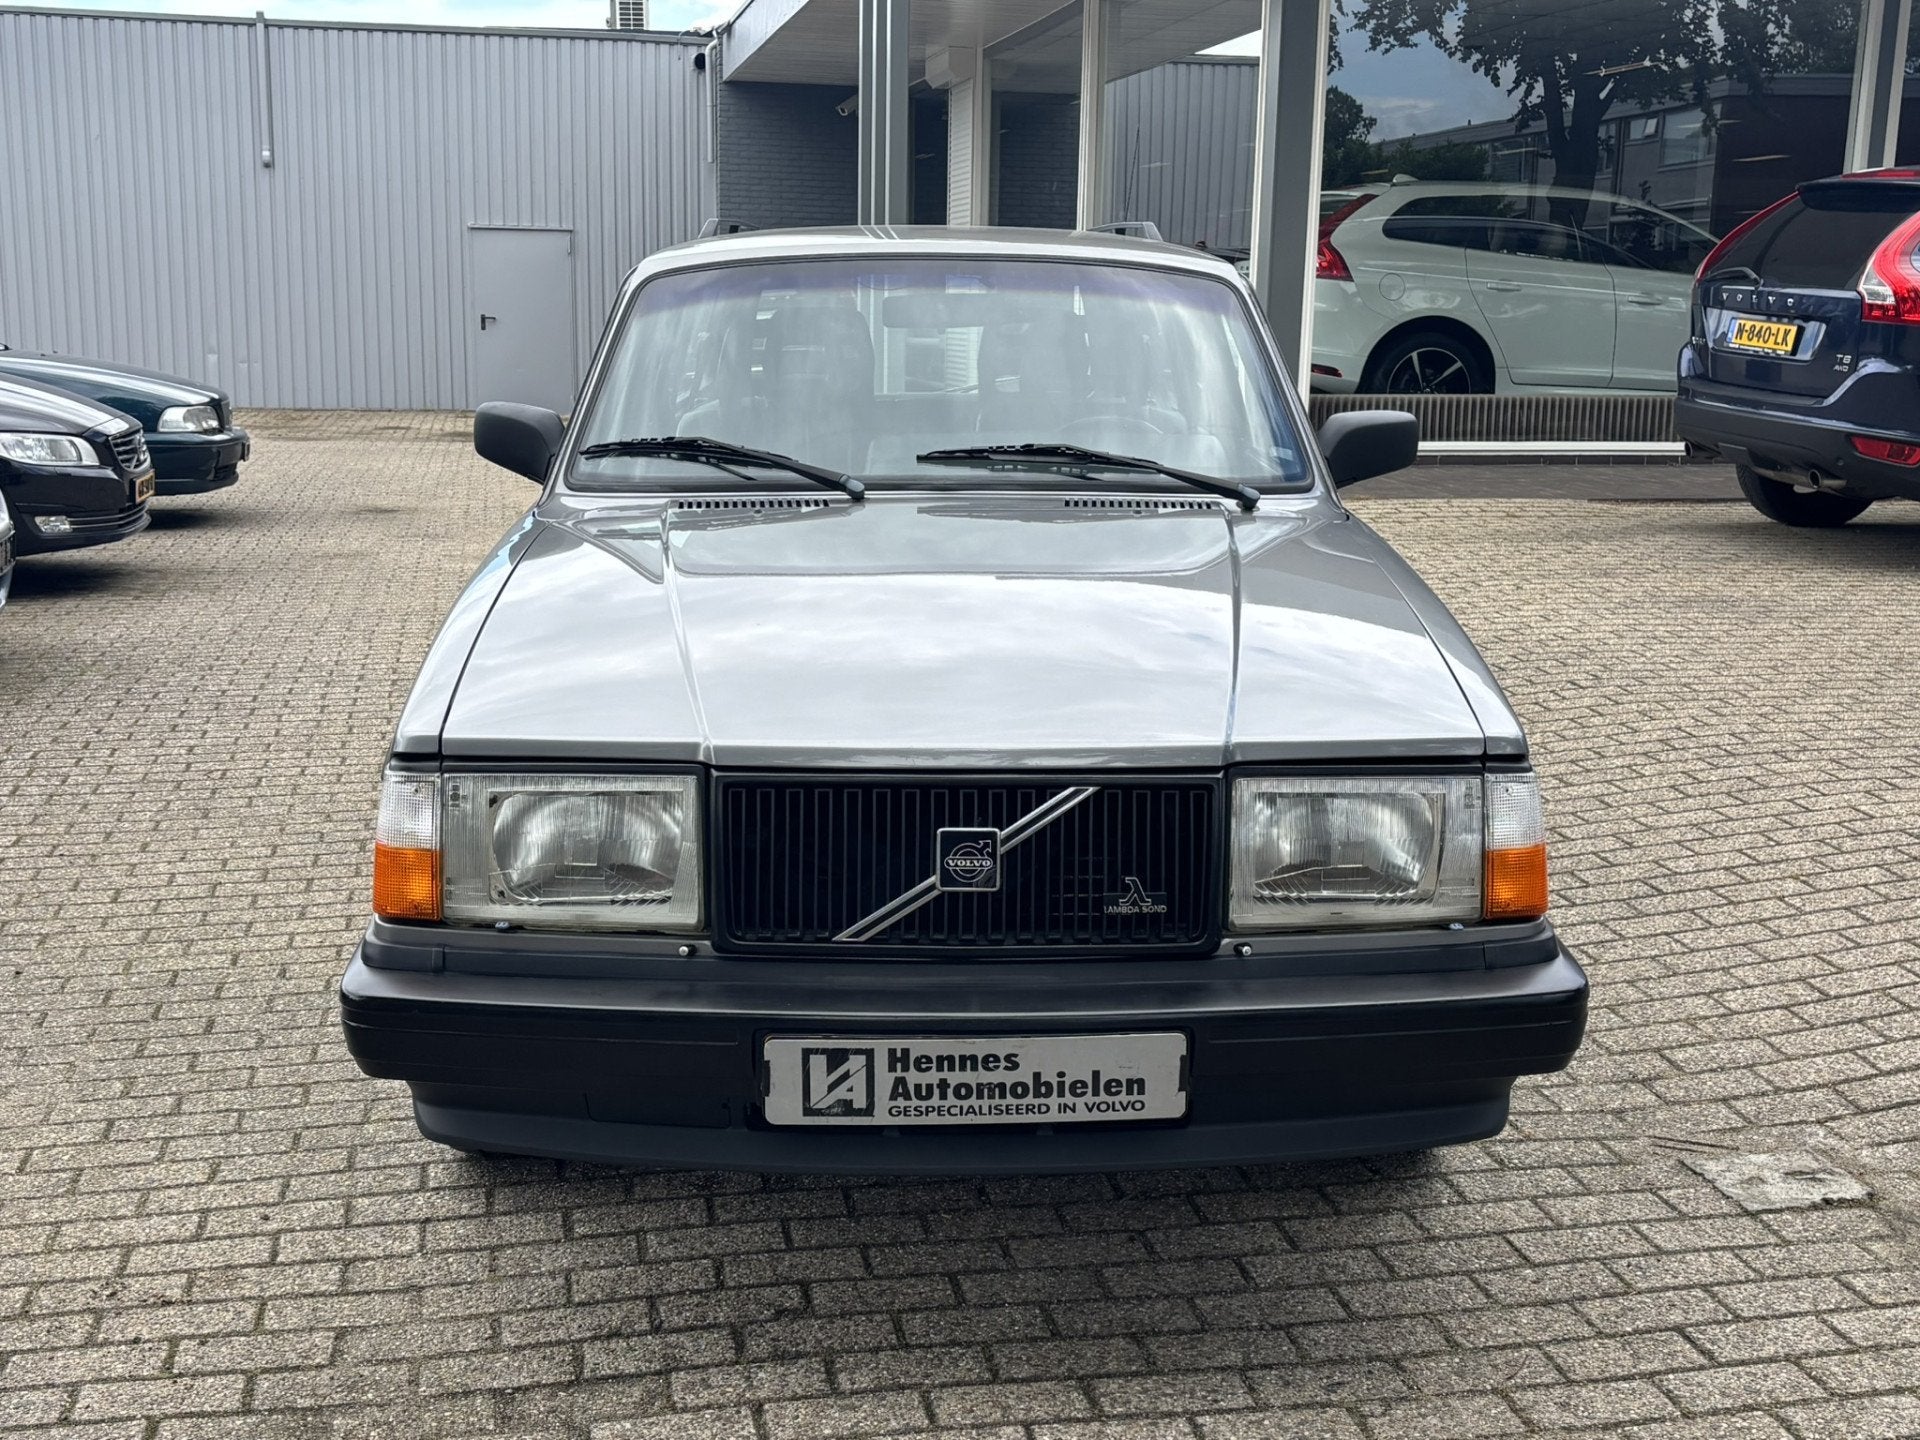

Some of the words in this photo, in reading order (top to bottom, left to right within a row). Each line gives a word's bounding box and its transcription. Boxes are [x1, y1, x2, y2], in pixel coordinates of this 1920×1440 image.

[1722, 292, 1794, 307] VOLVO
[1735, 322, 1792, 347] N-840-LK
[947, 859, 991, 867] VOLVO
[1103, 905, 1140, 914] LAMBDA
[1142, 904, 1167, 913] SOND
[887, 1047, 1020, 1073] Hennes
[888, 1069, 1146, 1101] Automobielen
[888, 1102, 1051, 1118] GESPECIALISEERD
[1057, 1102, 1077, 1114] IN
[1084, 1099, 1146, 1114] VOLVO
